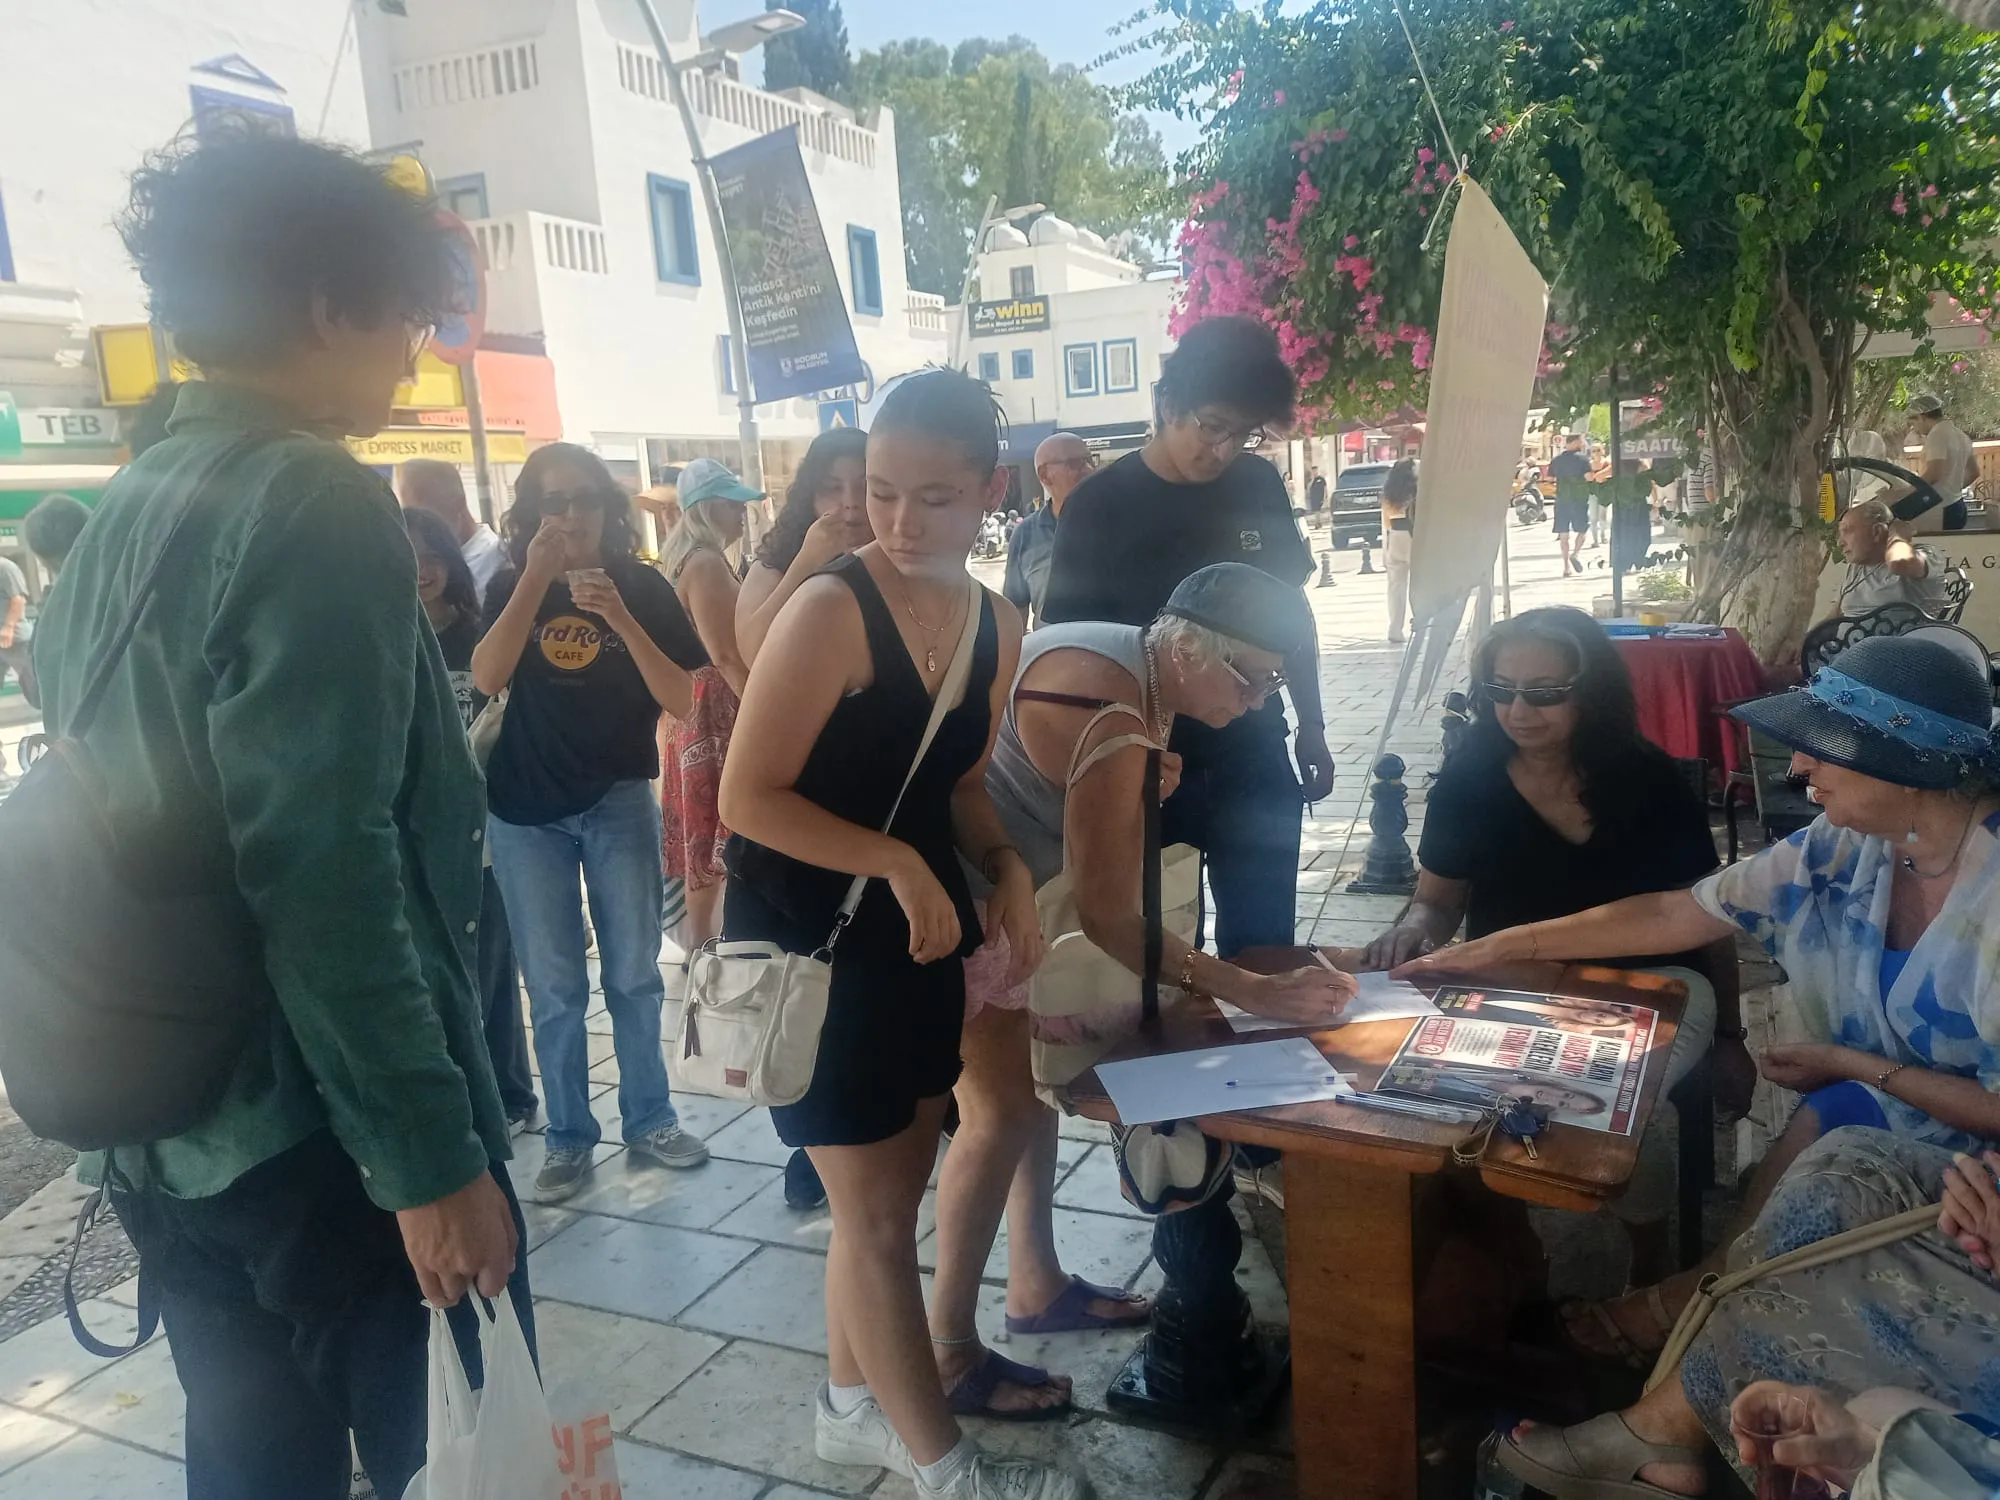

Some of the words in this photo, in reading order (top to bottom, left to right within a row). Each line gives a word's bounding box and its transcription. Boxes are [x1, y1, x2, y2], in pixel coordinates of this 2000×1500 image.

[743, 294, 774, 311] Antik
[996, 301, 1044, 320] winn
[37, 414, 102, 436] TEB
[368, 441, 416, 455] EXPRESS
[421, 440, 463, 454] MARKET
[555, 650, 585, 661] CAFE
[1522, 1030, 1562, 1072] ERKEKLERİN
[1588, 1041, 1622, 1082] KADINLARIN
